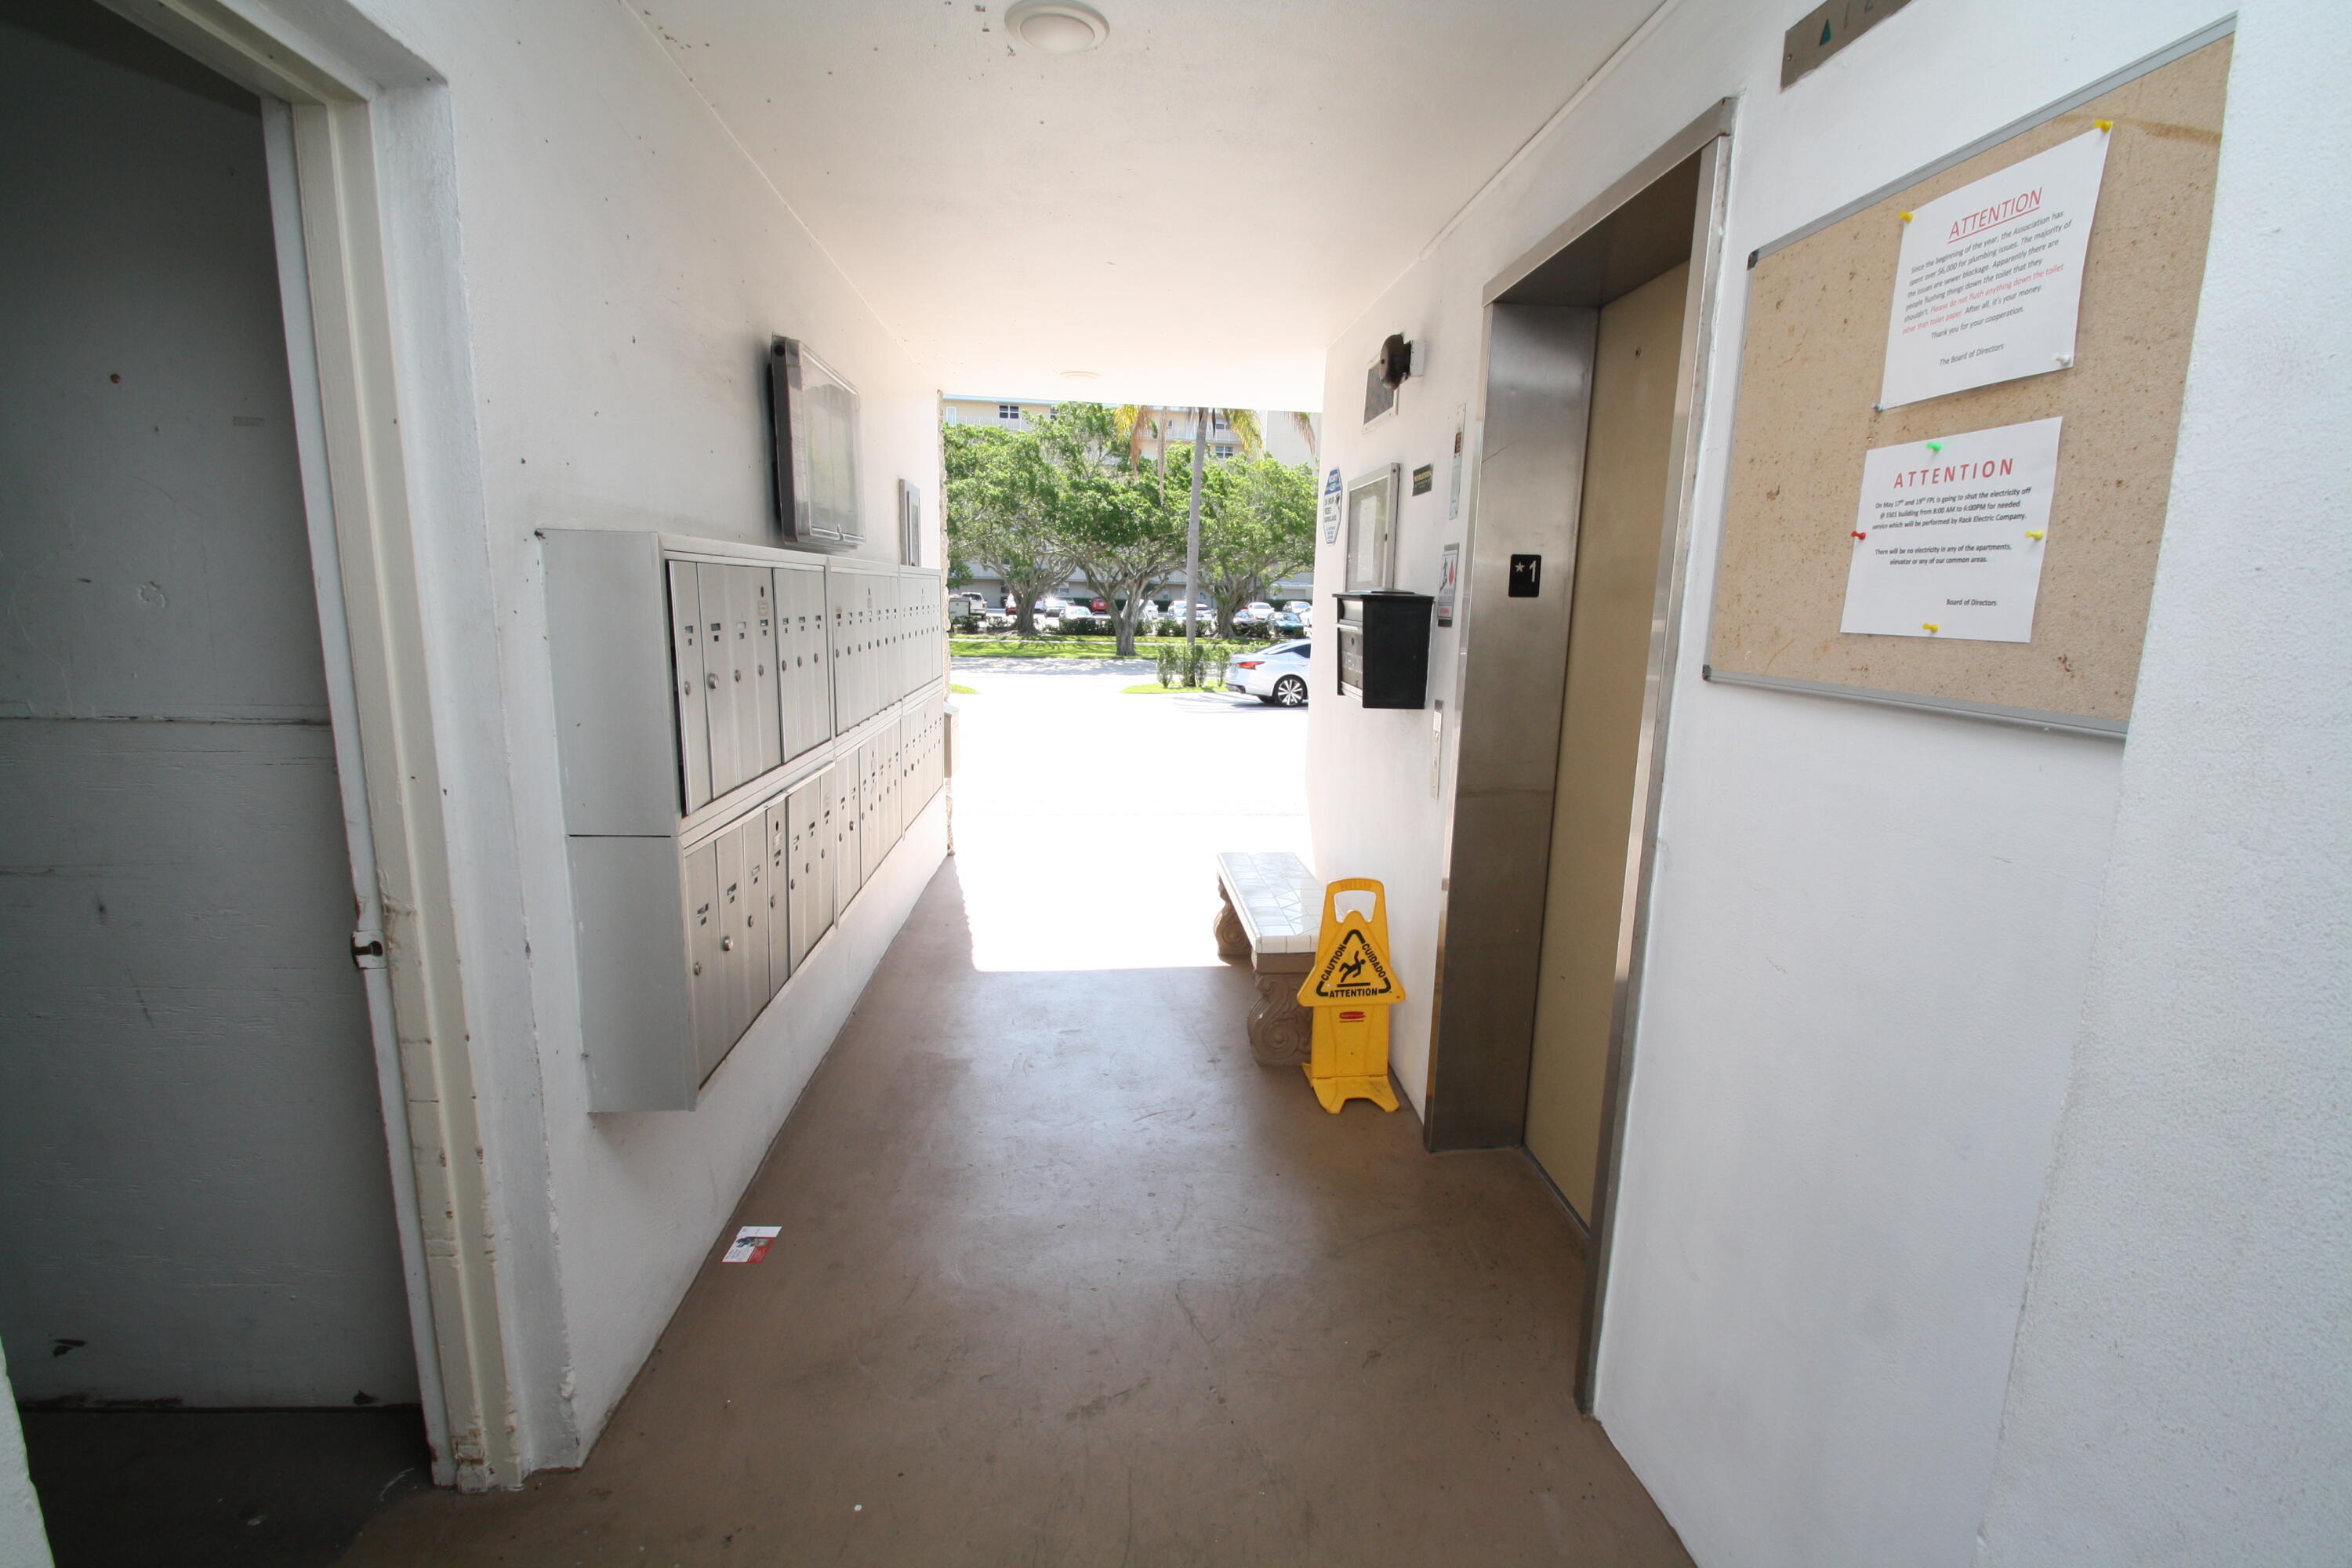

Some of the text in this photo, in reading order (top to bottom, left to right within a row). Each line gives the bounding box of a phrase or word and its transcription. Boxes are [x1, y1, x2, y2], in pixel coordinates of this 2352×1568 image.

[1949, 187, 2042, 238] ATTENTION
[1909, 276, 1923, 286] spent
[1925, 271, 1936, 280] over
[1967, 249, 1997, 266] plumbing
[2034, 225, 2063, 240] majority
[2063, 219, 2072, 229] of
[1935, 249, 1964, 264] beginning
[1965, 245, 1972, 253] of
[2013, 216, 2050, 235] Association
[2051, 211, 2063, 220] has
[1944, 274, 1961, 285] sewer
[1992, 251, 2027, 268] Apparently
[2028, 245, 2046, 255] there
[2047, 240, 2059, 249] are
[1905, 299, 1923, 311] people
[1947, 285, 1964, 296] things
[1965, 280, 1982, 289] down
[1995, 268, 2012, 279] toilet
[2013, 263, 2026, 273] that
[2027, 259, 2042, 268] they
[1930, 303, 1947, 313] Please
[1958, 296, 1968, 304] not
[1969, 290, 1984, 300] flush
[1985, 282, 2012, 296] anything
[2013, 276, 2031, 286] down
[2045, 263, 2063, 275] toilet
[1929, 316, 1944, 325] toilet
[1965, 305, 1980, 314] After
[2002, 292, 2017, 303] your
[1931, 328, 1947, 339] Thank
[1948, 326, 1959, 336] you
[1969, 319, 1984, 328] your
[1951, 352, 1967, 363] Board
[1976, 344, 2004, 356] Directors
[1893, 458, 2013, 488] ATTENTION
[1922, 518, 1950, 527] performed
[1529, 560, 1537, 583] 1
[1320, 943, 1347, 982] CAUTION
[1362, 942, 1387, 979] CUIDADO
[1329, 987, 1378, 998] ATTENTION
